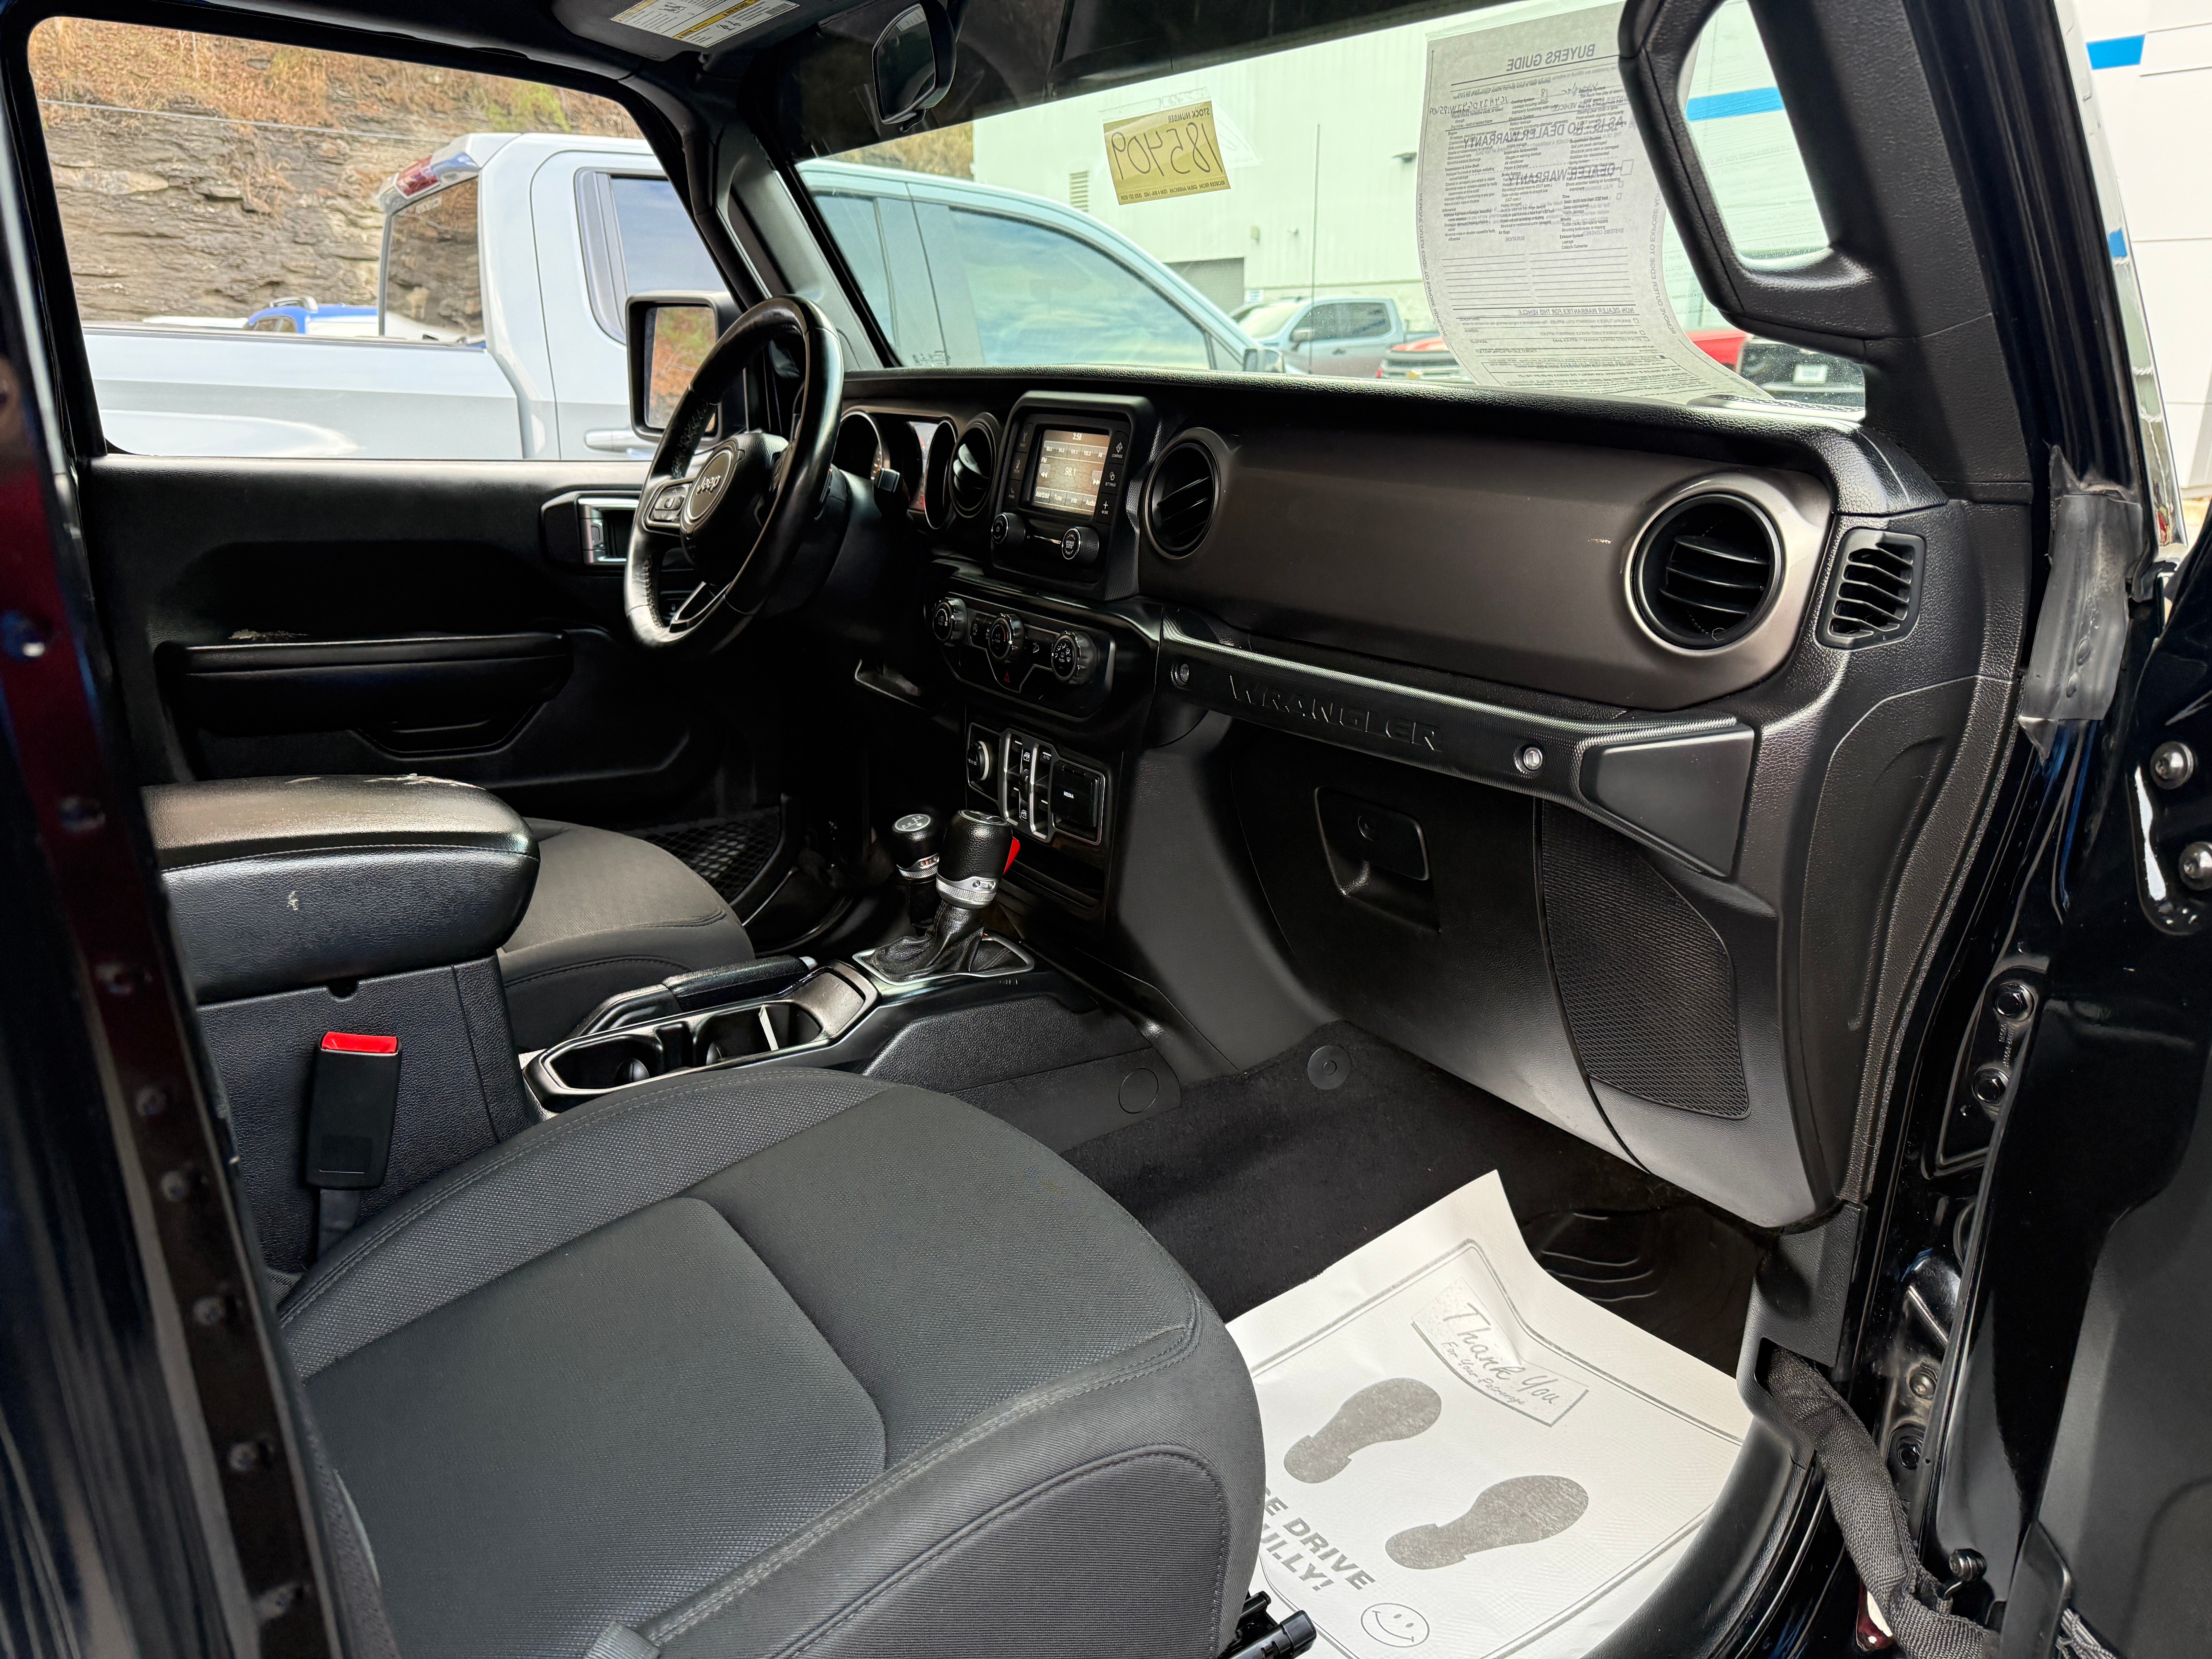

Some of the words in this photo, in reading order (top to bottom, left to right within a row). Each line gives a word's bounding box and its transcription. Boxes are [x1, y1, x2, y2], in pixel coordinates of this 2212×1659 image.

[1072, 433, 1082, 441] 3:58
[696, 475, 721, 495] Jeep
[1065, 467, 1076, 477] 98.1
[1229, 675, 1442, 752] WRANGLER
[1441, 1341, 1458, 1359] For
[1458, 1358, 1479, 1381] Your
[1442, 1302, 1526, 1381] Thank
[1516, 1375, 1560, 1405] You
[1282, 1516, 1376, 1591] DRIVE
